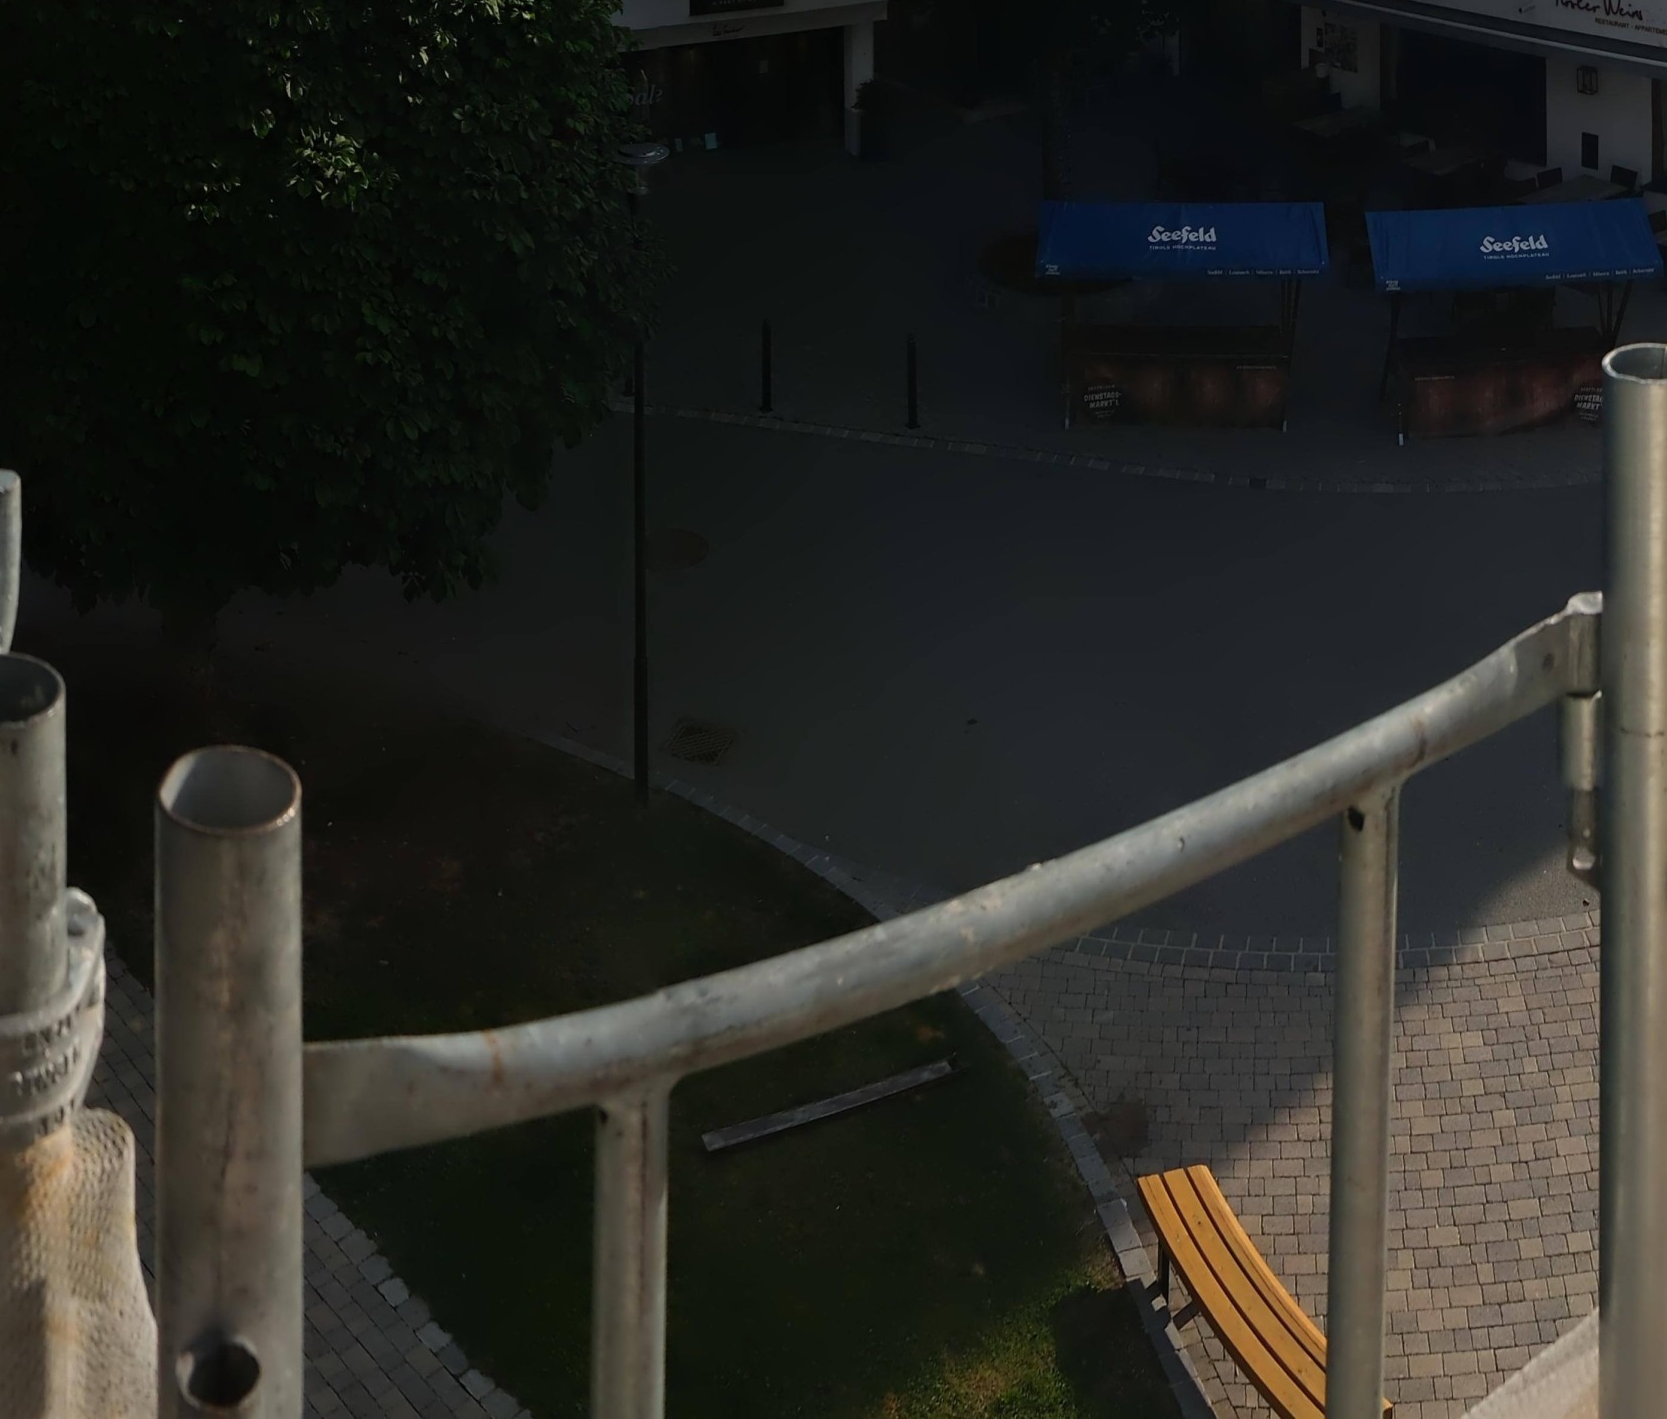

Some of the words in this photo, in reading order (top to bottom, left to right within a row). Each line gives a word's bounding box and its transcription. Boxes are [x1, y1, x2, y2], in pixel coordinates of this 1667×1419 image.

[1595, 17, 1629, 29] RESTAURANT
[1147, 225, 1216, 244] Seefeld
[1479, 235, 1548, 254] Seefeld
